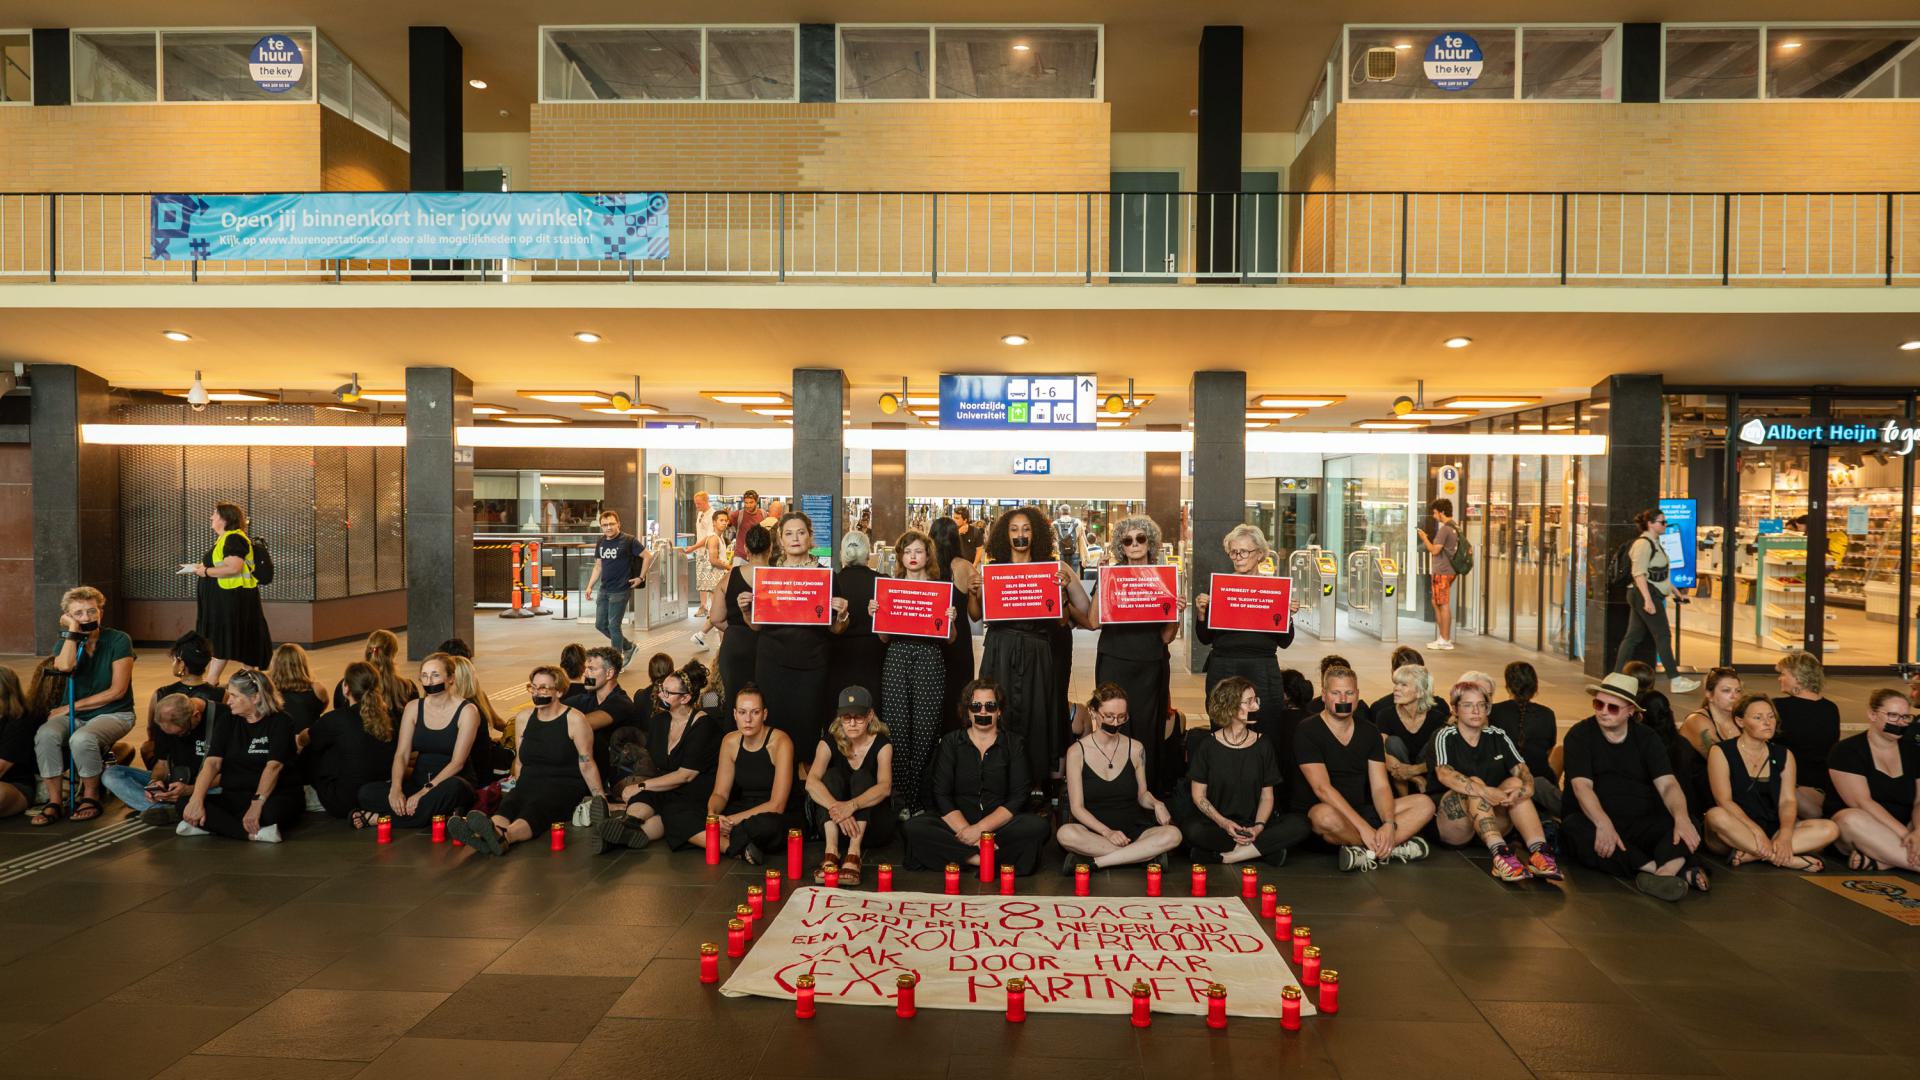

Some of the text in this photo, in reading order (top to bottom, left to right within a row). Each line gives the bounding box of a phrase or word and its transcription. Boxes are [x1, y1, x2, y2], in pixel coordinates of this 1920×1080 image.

[268, 38, 284, 50] te
[1445, 35, 1462, 48] te
[260, 47, 294, 61] huur
[1435, 45, 1473, 59] huur
[260, 67, 292, 77] the key
[1436, 65, 1471, 75] the key
[221, 208, 593, 232] Open jij binnenkort hier jouw winkel?
[219, 233, 593, 247] Kijk op www.hurenopstations.nl voor alle mogelijkheden op dit station!
[960, 402, 1006, 411] Noordzijde
[956, 412, 1006, 420] Universiteit
[1056, 414, 1072, 422] WC
[1767, 425, 1824, 440] Albert
[1830, 425, 1877, 442] Heijn
[600, 547, 617, 559] Lee
[808, 888, 1230, 930] IEDERE 8 DAGEN
[801, 912, 1228, 934] WORDT ER IN NEDERLAND
[792, 924, 1264, 953] EEN VROUW VERMOORD
[800, 943, 1213, 973] VAAK DOOR HAAR
